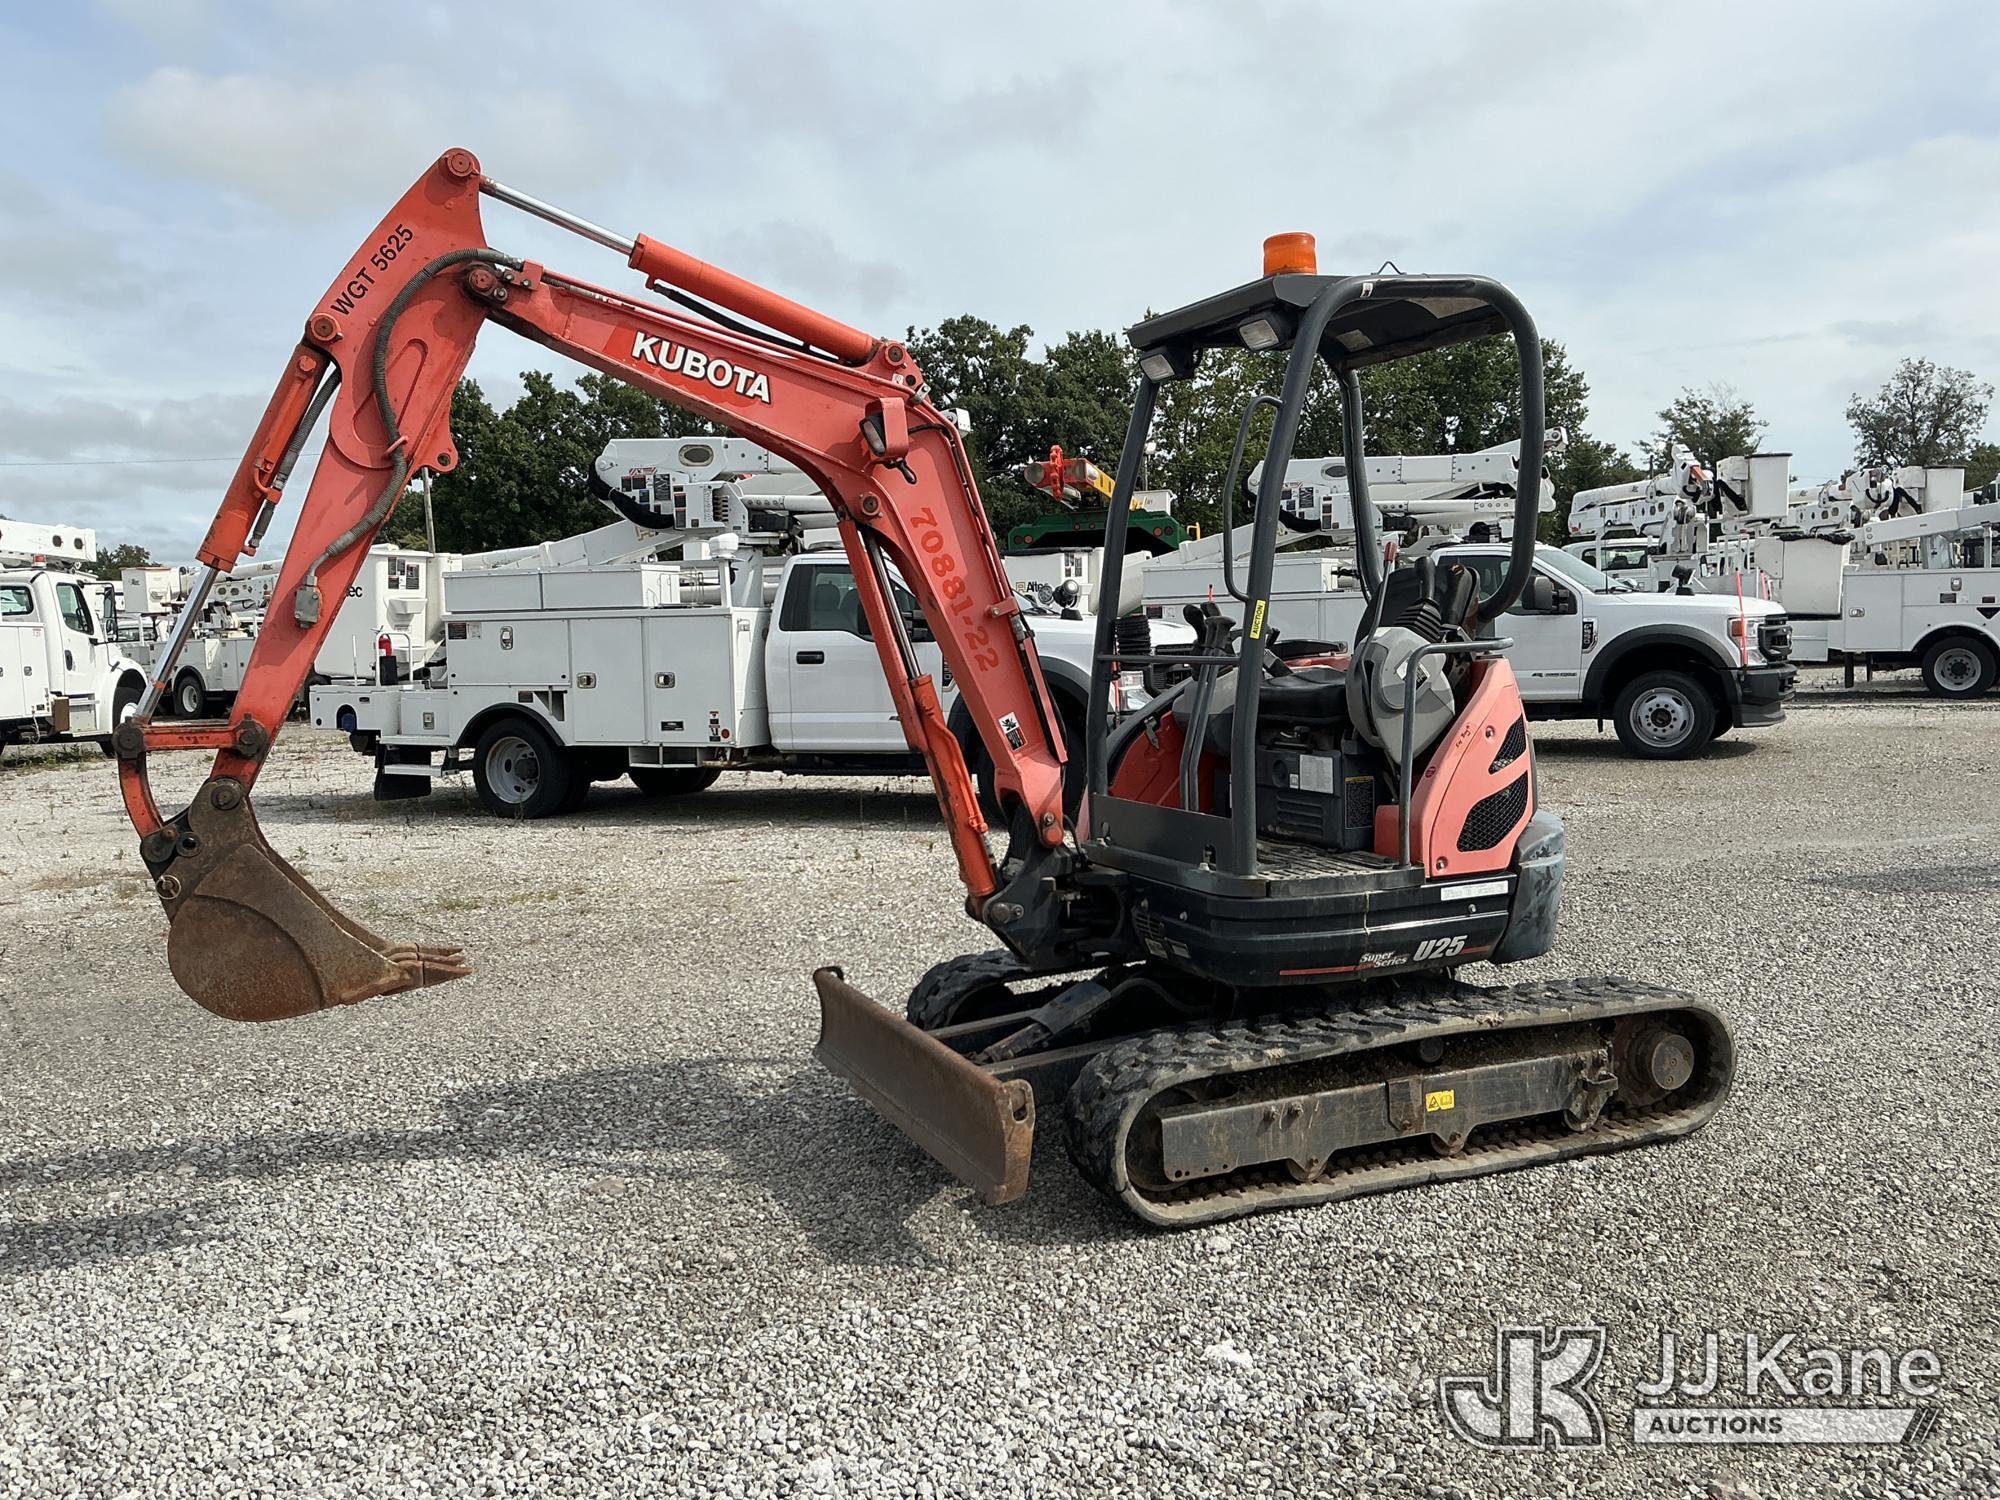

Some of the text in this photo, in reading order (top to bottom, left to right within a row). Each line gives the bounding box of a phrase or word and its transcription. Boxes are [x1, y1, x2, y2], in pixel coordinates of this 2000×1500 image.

[330, 223, 414, 316] WGT 5625
[630, 330, 772, 404] KUBOTA
[909, 507, 1000, 673] 70881-22
[1026, 581, 1048, 593] Alte
[1252, 604, 1264, 635] AUCTION
[1360, 950, 1396, 964] Super
[1373, 955, 1409, 969] Series
[1412, 934, 1468, 962] U25
